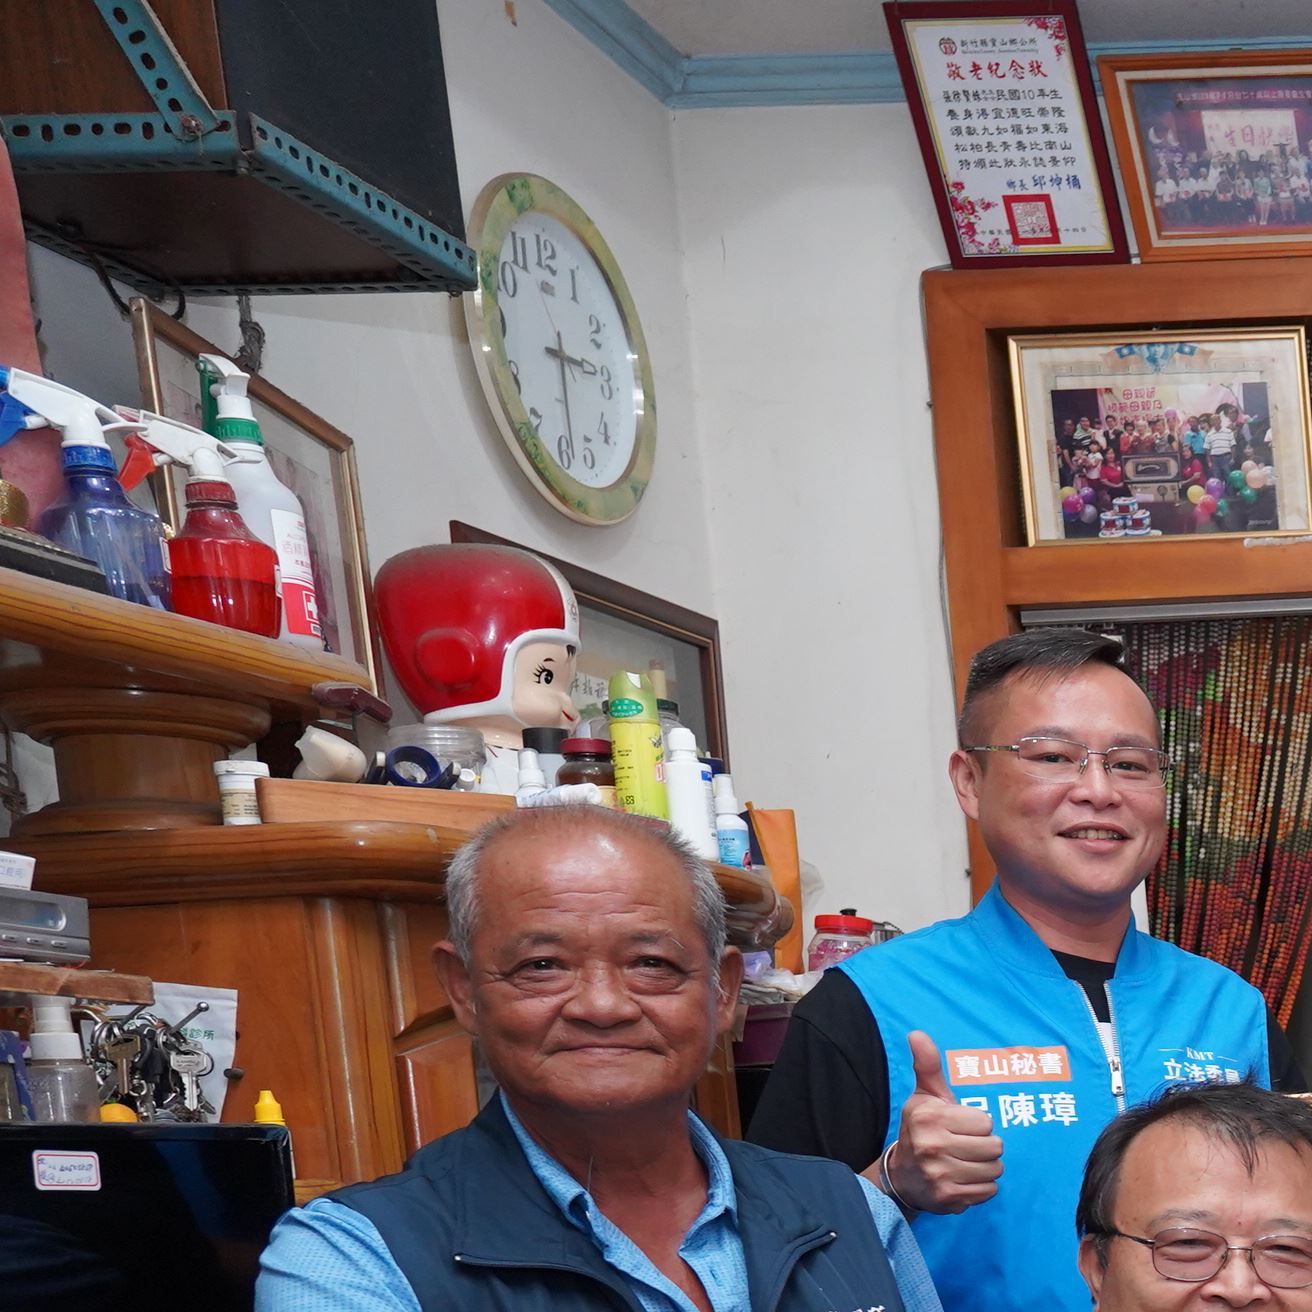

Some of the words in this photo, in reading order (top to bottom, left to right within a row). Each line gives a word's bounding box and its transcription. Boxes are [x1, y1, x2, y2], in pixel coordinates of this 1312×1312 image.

[535, 229, 557, 276] 12
[570, 268, 580, 304] 1
[589, 313, 605, 350] 2
[601, 365, 613, 400] 3
[598, 413, 611, 446] 4
[557, 435, 572, 471] 6
[583, 436, 596, 470] 5
[954, 1052, 1064, 1079] 寶山秘書
[1187, 1047, 1214, 1061] KMT
